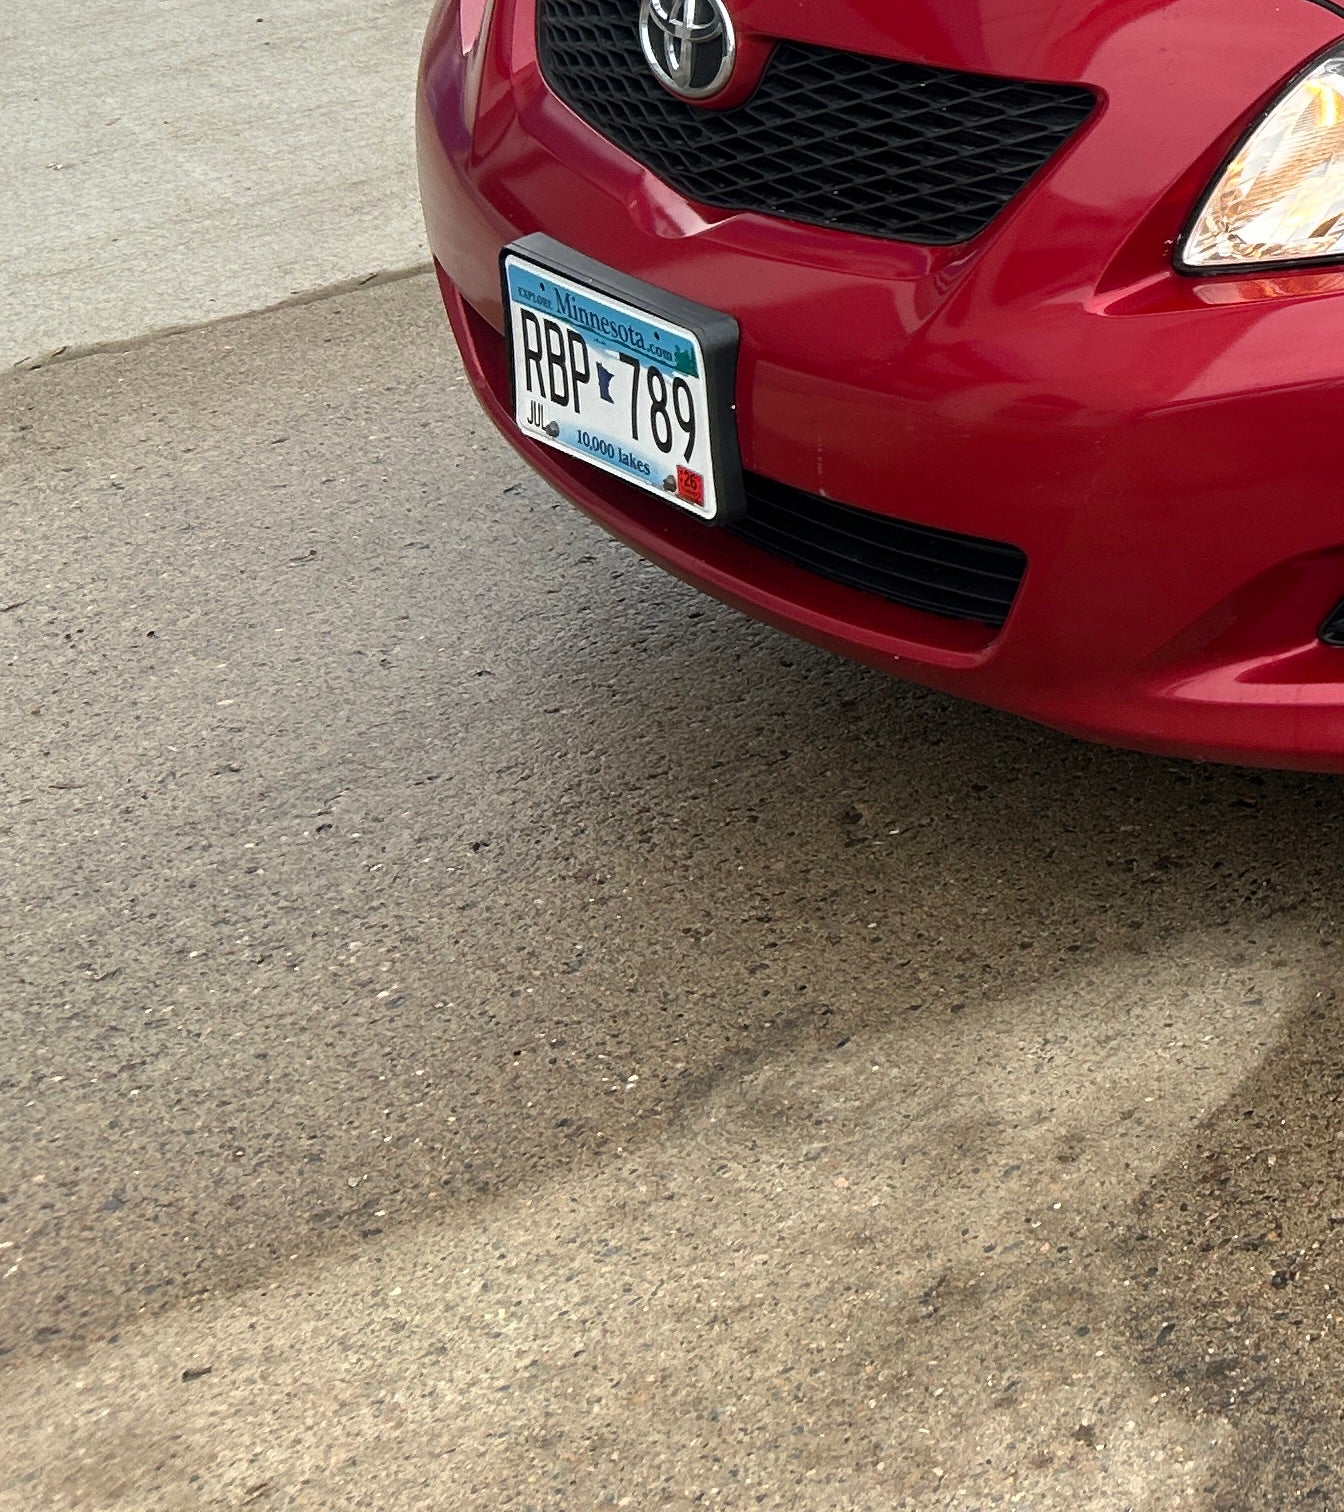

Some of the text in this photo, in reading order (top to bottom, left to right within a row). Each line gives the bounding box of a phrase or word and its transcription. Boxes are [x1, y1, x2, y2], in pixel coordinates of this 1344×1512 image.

[520, 307, 697, 463] RBP 789
[527, 399, 547, 431] JUL
[576, 429, 651, 476] 10,000 lakes
[683, 472, 698, 490] 26
